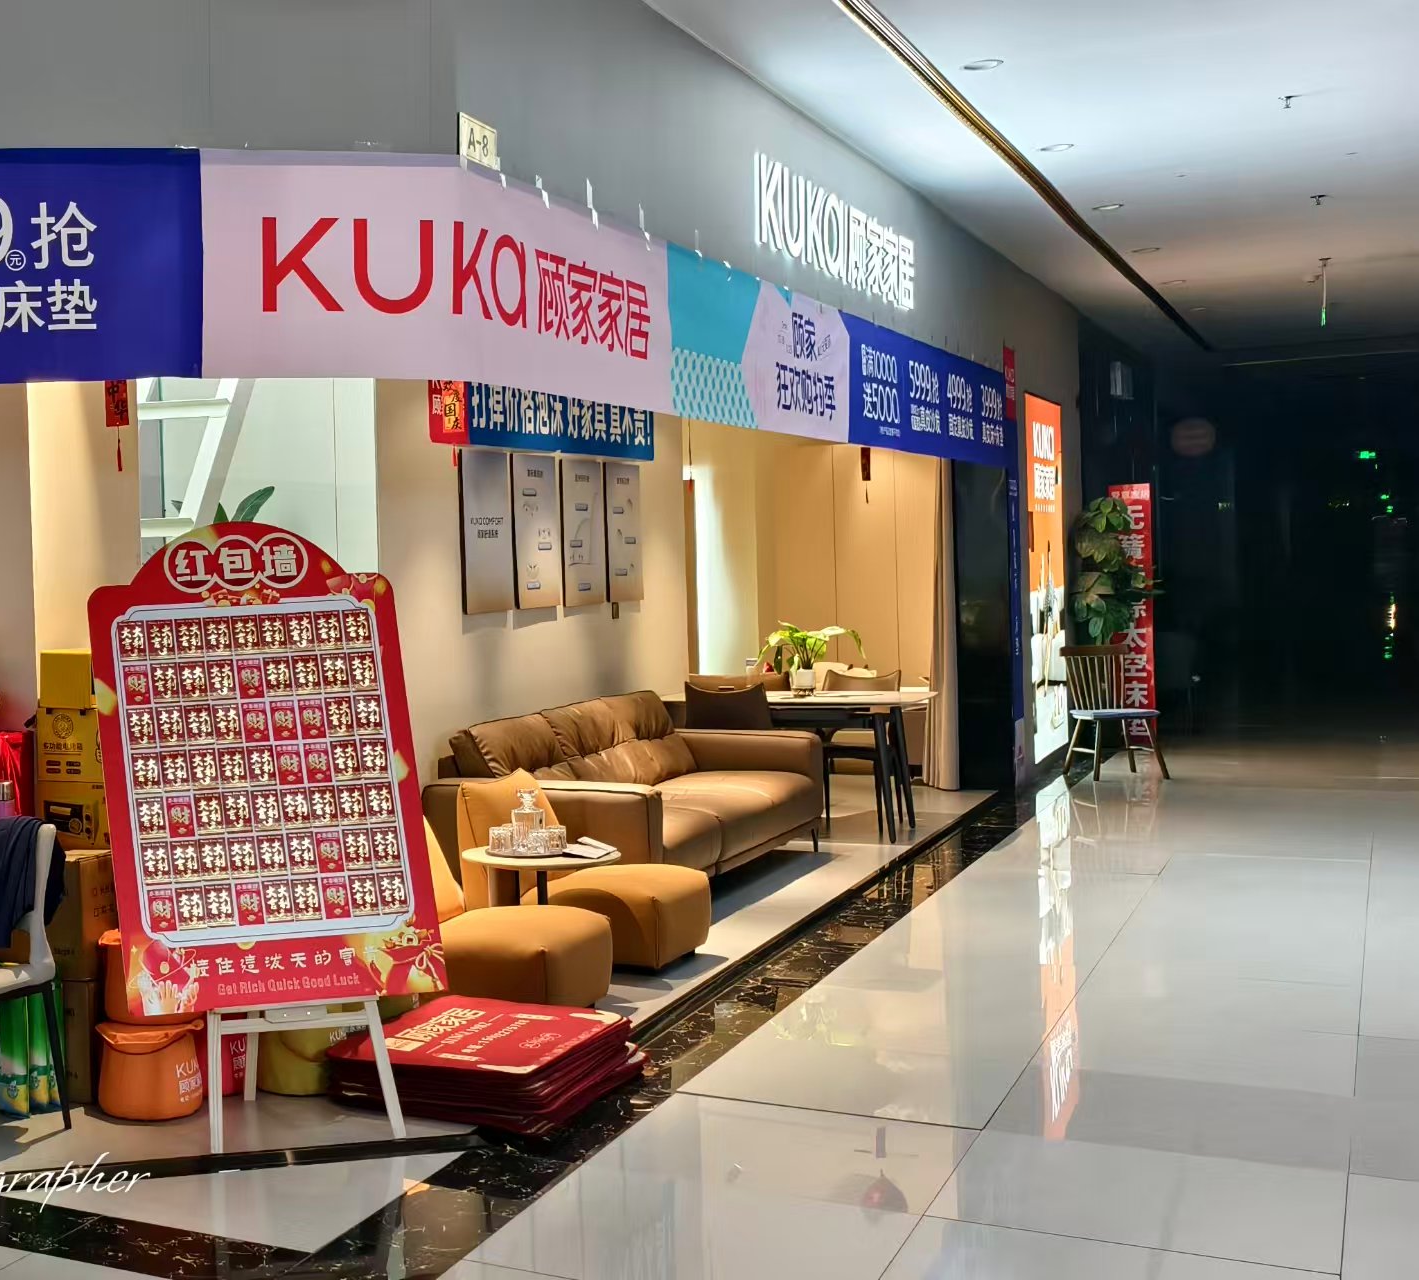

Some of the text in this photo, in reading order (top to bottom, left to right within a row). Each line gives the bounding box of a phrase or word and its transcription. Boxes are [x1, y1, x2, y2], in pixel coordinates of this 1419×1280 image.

[467, 127, 490, 158] A-8
[848, 206, 914, 310] 顾家家居
[534, 248, 651, 361] 顾家家居
[791, 312, 818, 361] 顾家
[776, 361, 836, 421] 狂欢购物季
[175, 544, 296, 582] 红包墙
[217, 972, 361, 996] Get Rich Quick Good Luck
